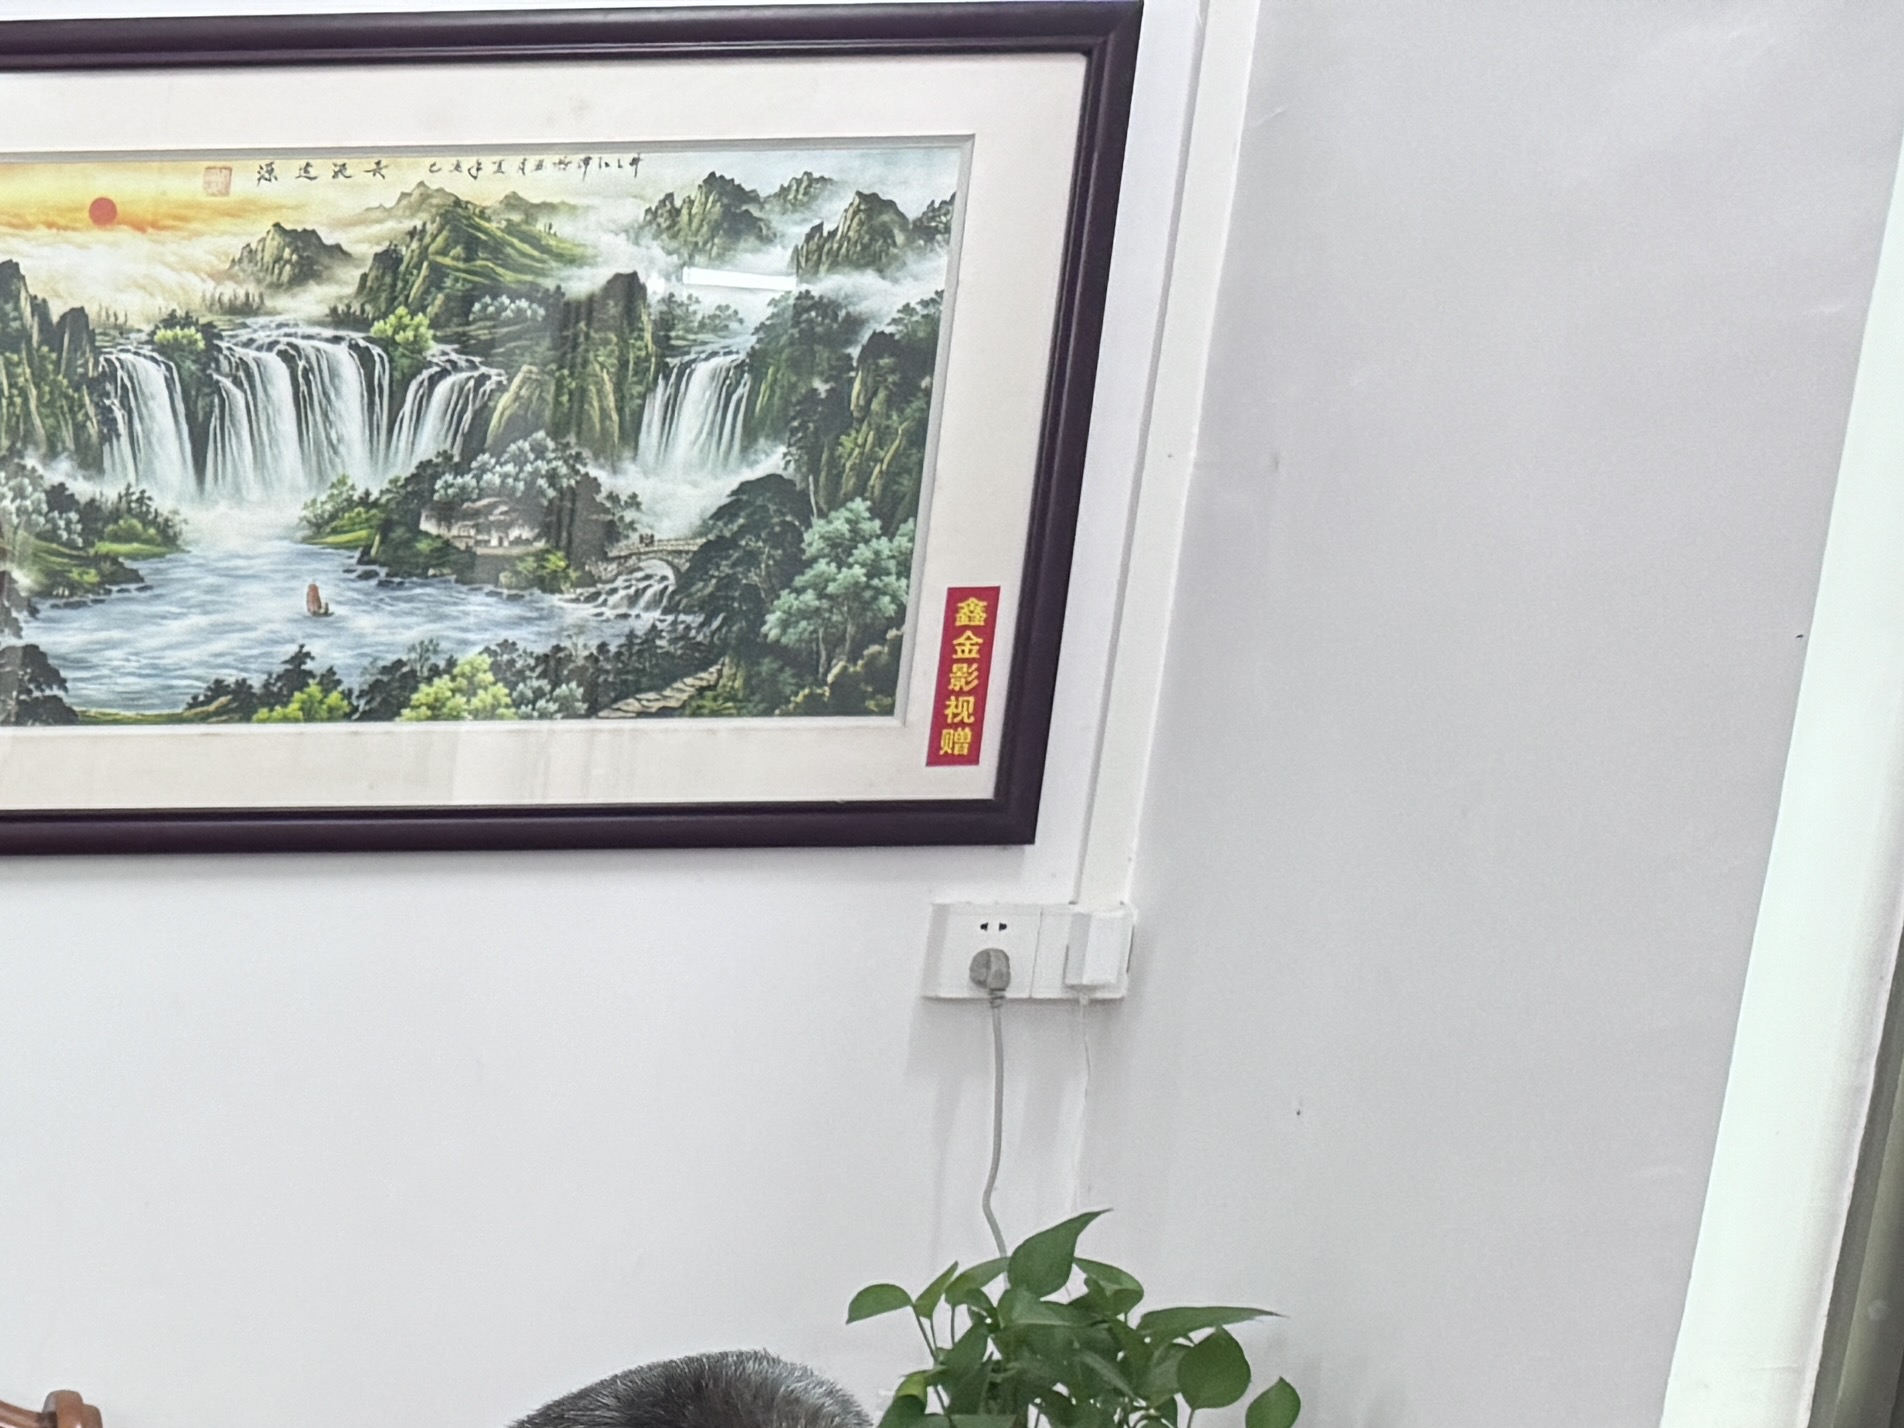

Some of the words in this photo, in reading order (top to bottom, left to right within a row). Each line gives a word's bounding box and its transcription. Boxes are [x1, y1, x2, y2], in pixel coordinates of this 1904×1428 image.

[939, 596, 988, 756] 鑫金影视赠
